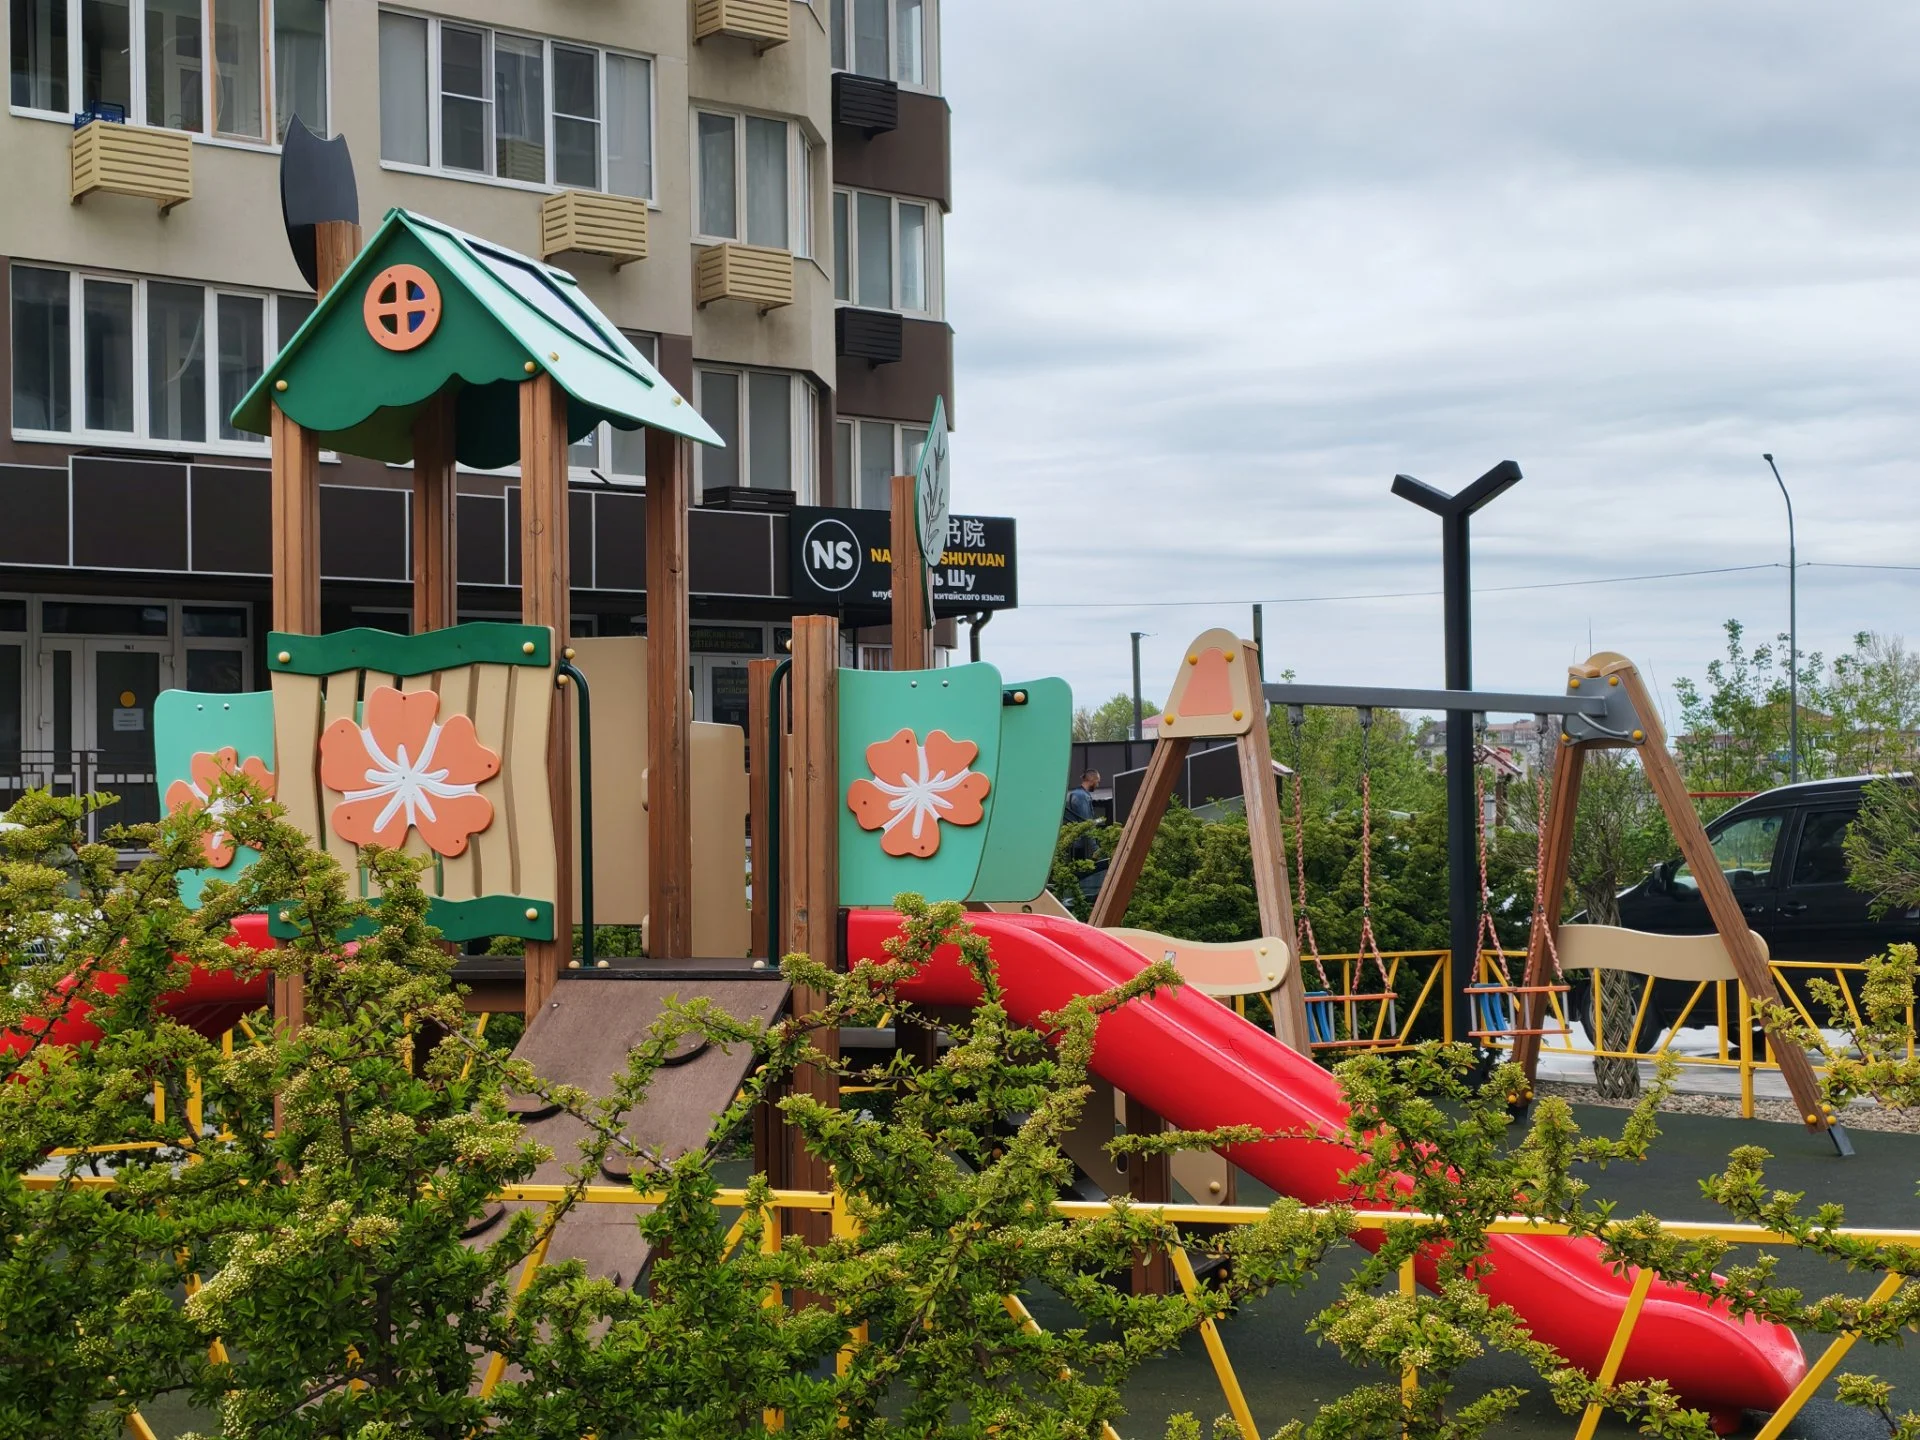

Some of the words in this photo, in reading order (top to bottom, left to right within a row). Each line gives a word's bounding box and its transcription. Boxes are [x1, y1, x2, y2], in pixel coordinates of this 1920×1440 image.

[811, 540, 853, 570] NS
[870, 548, 892, 563] NA
[940, 551, 1005, 568] SHUYUAN
[948, 569, 976, 591] Шу
[934, 591, 980, 601] китайского
[981, 594, 1005, 602] языка
